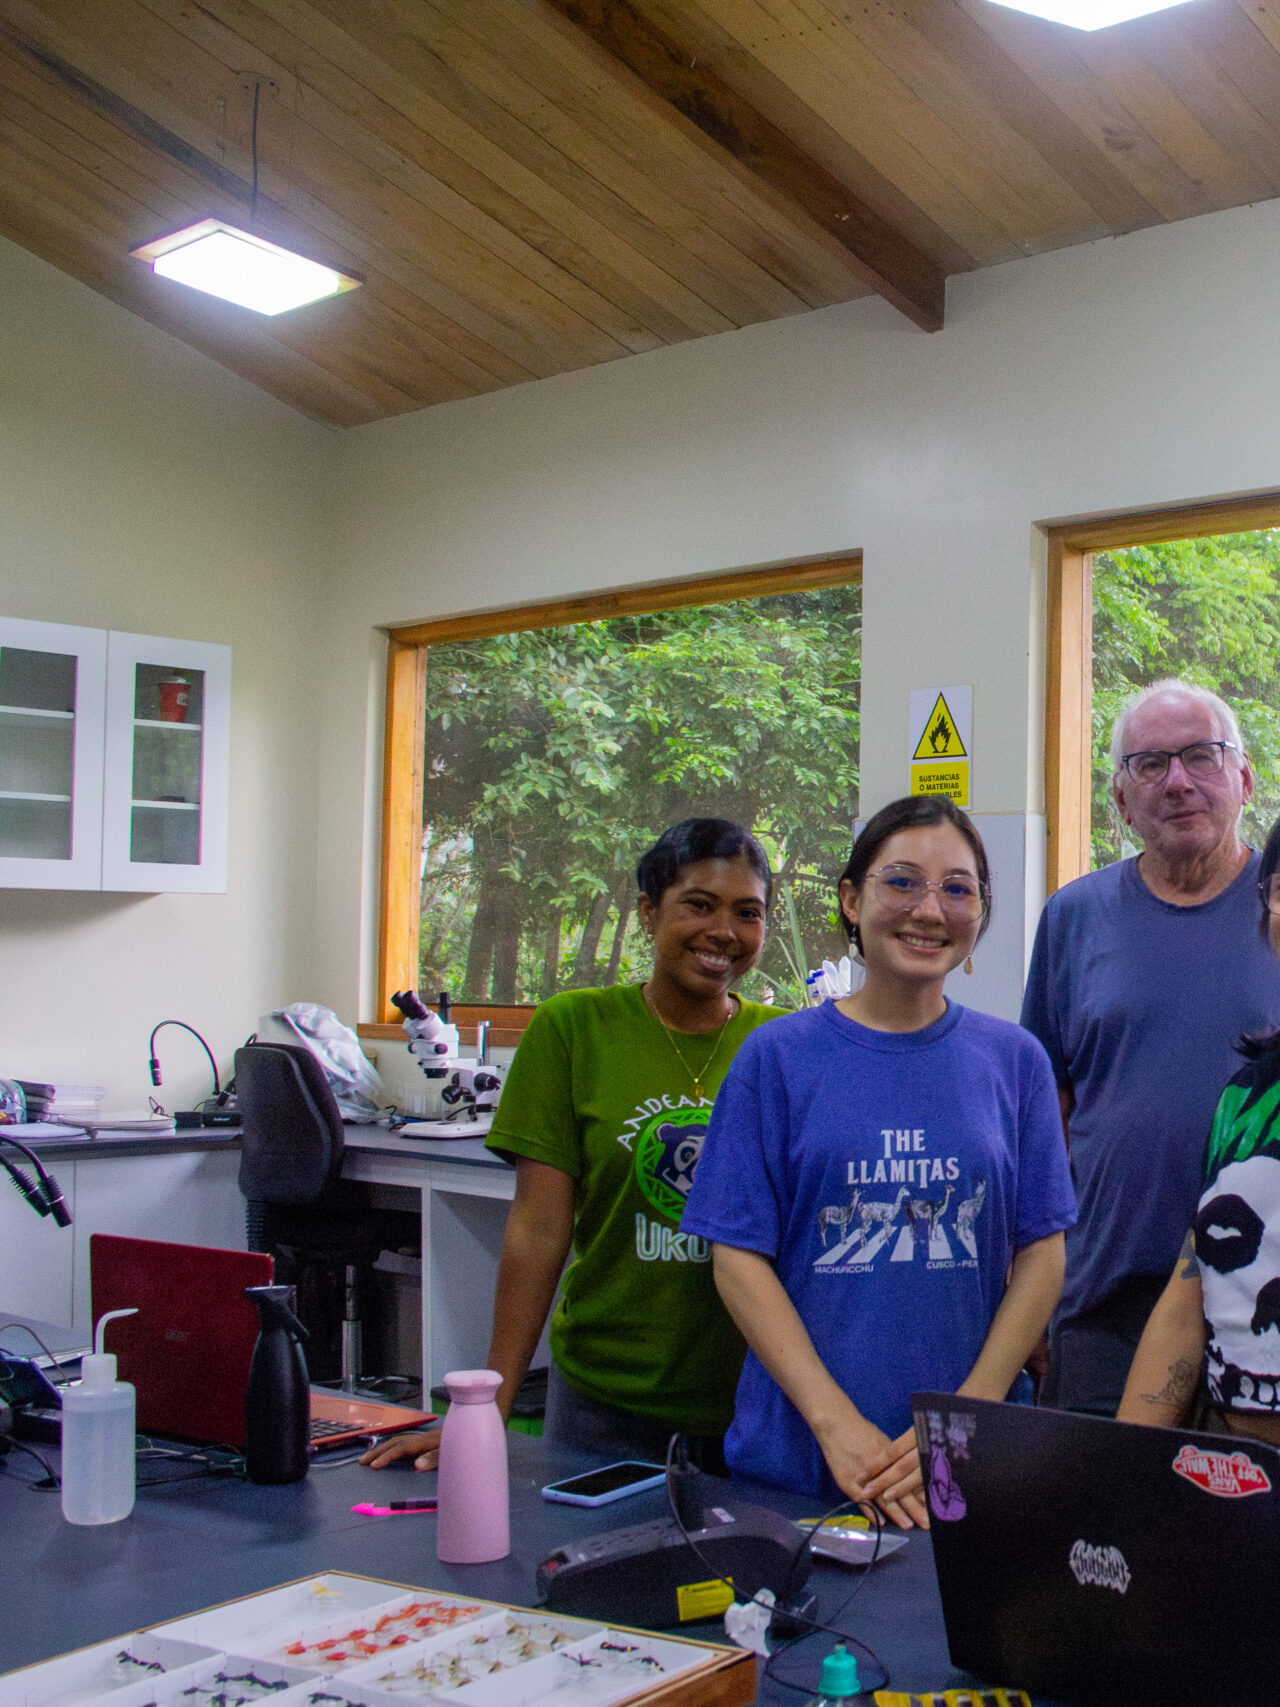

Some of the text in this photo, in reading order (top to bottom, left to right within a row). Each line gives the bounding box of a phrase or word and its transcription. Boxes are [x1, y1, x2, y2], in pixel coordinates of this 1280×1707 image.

[918, 774, 960, 783] SUSTANCIAS
[926, 782, 960, 791] MATERIAS
[881, 1129, 926, 1158] THE
[847, 1157, 960, 1189] LLAMITAS
[926, 1260, 955, 1270] CUSCO
[1210, 1456, 1234, 1477] THE
